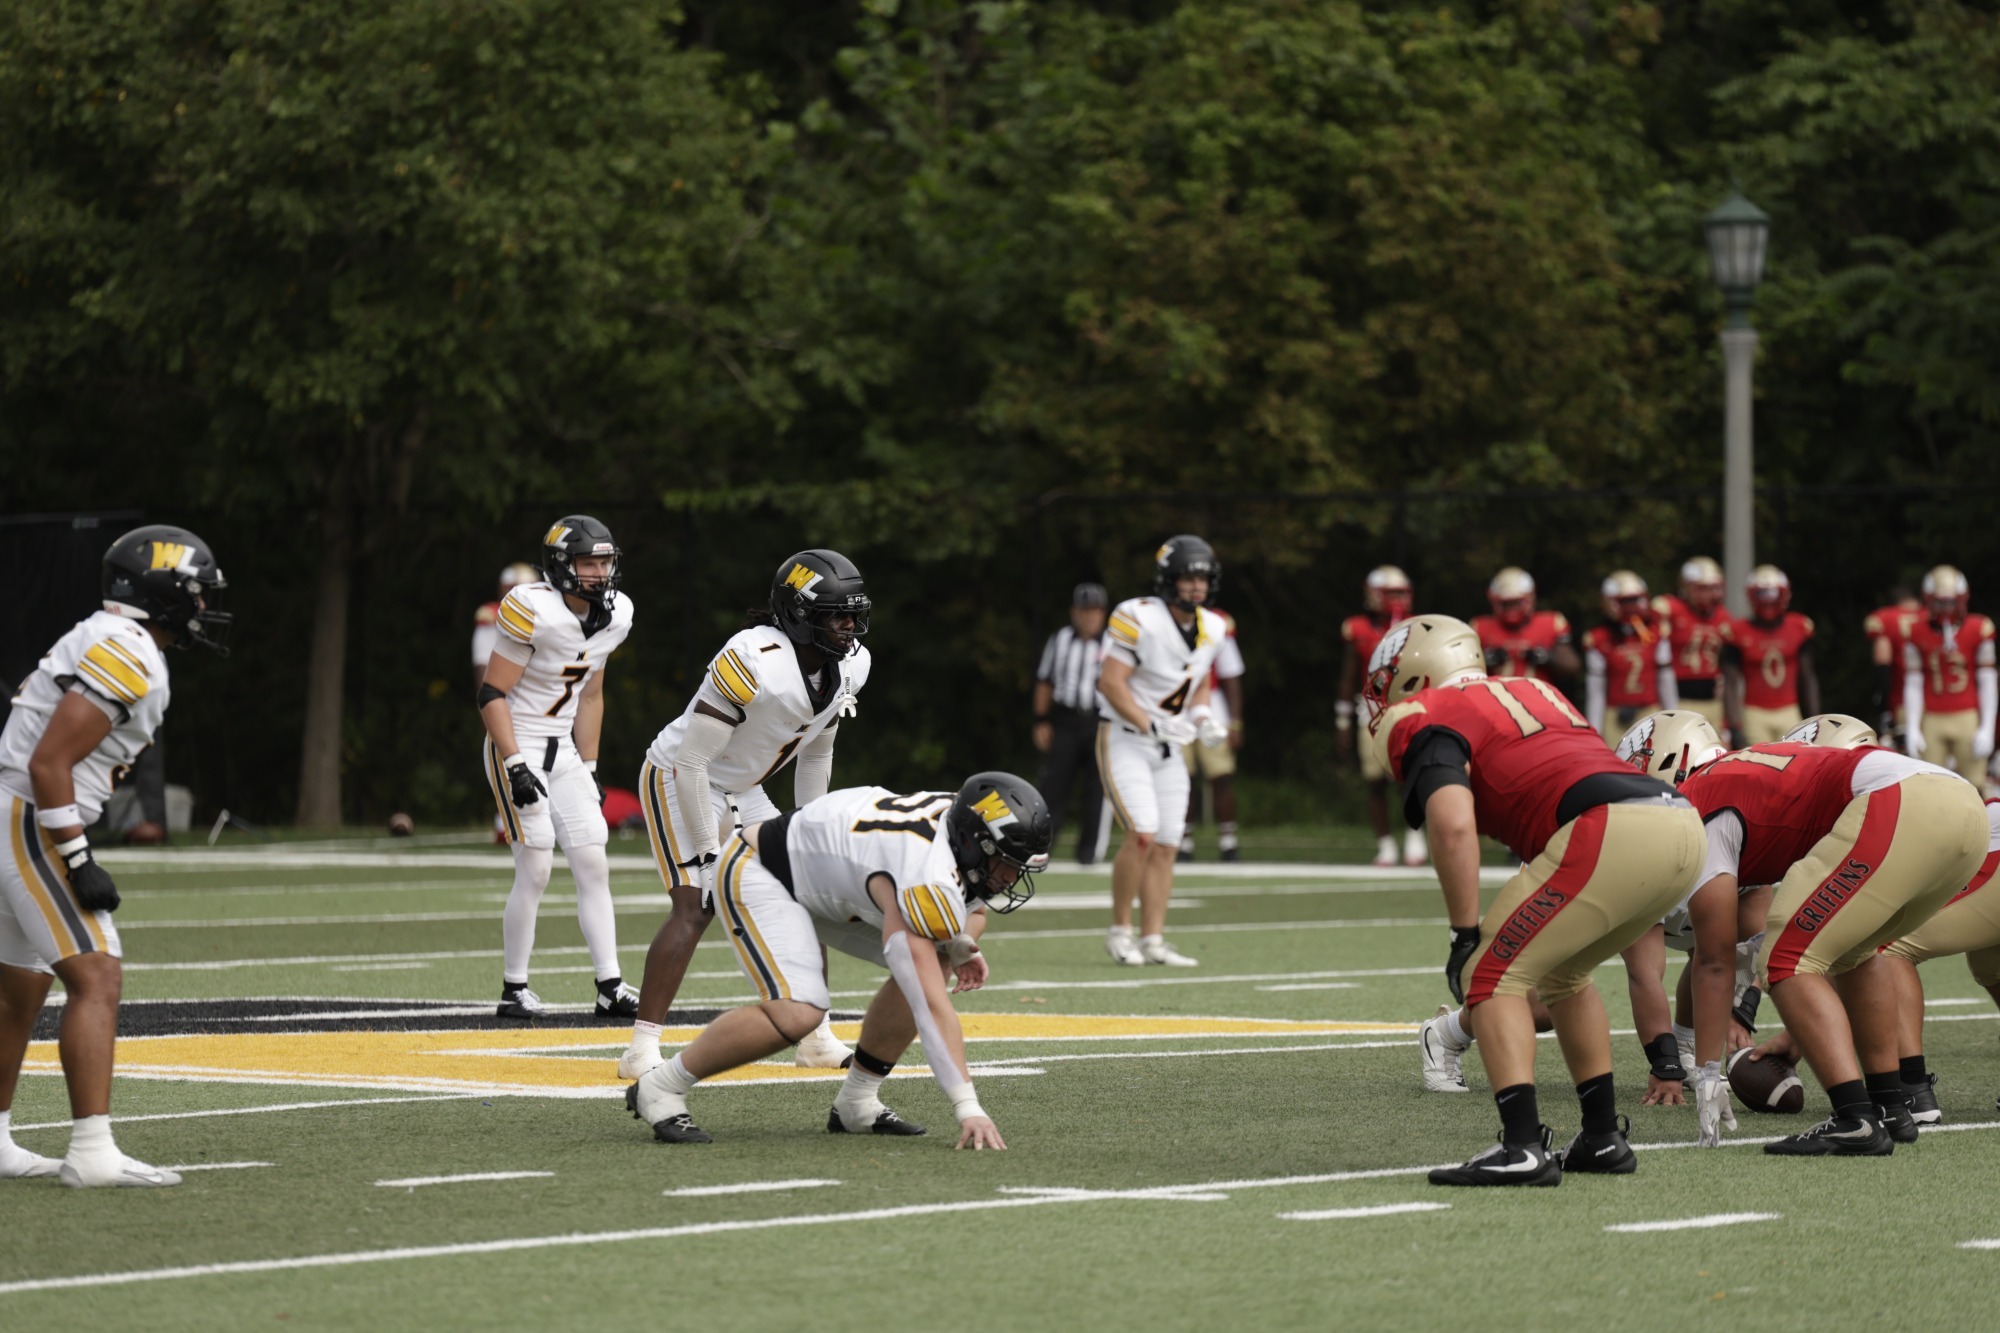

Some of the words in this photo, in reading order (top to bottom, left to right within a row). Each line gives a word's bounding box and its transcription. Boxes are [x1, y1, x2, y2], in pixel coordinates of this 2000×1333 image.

[152, 541, 199, 577] WL
[784, 563, 824, 601] WL
[544, 665, 591, 718] 7
[1761, 648, 1786, 690] 0
[1929, 647, 1969, 695] 13
[1158, 675, 1192, 716] 4
[752, 735, 804, 786] 1
[970, 790, 1020, 841] WL
[1795, 858, 1870, 933] GRIFFINS
[1492, 886, 1566, 960] GRIFFINS
